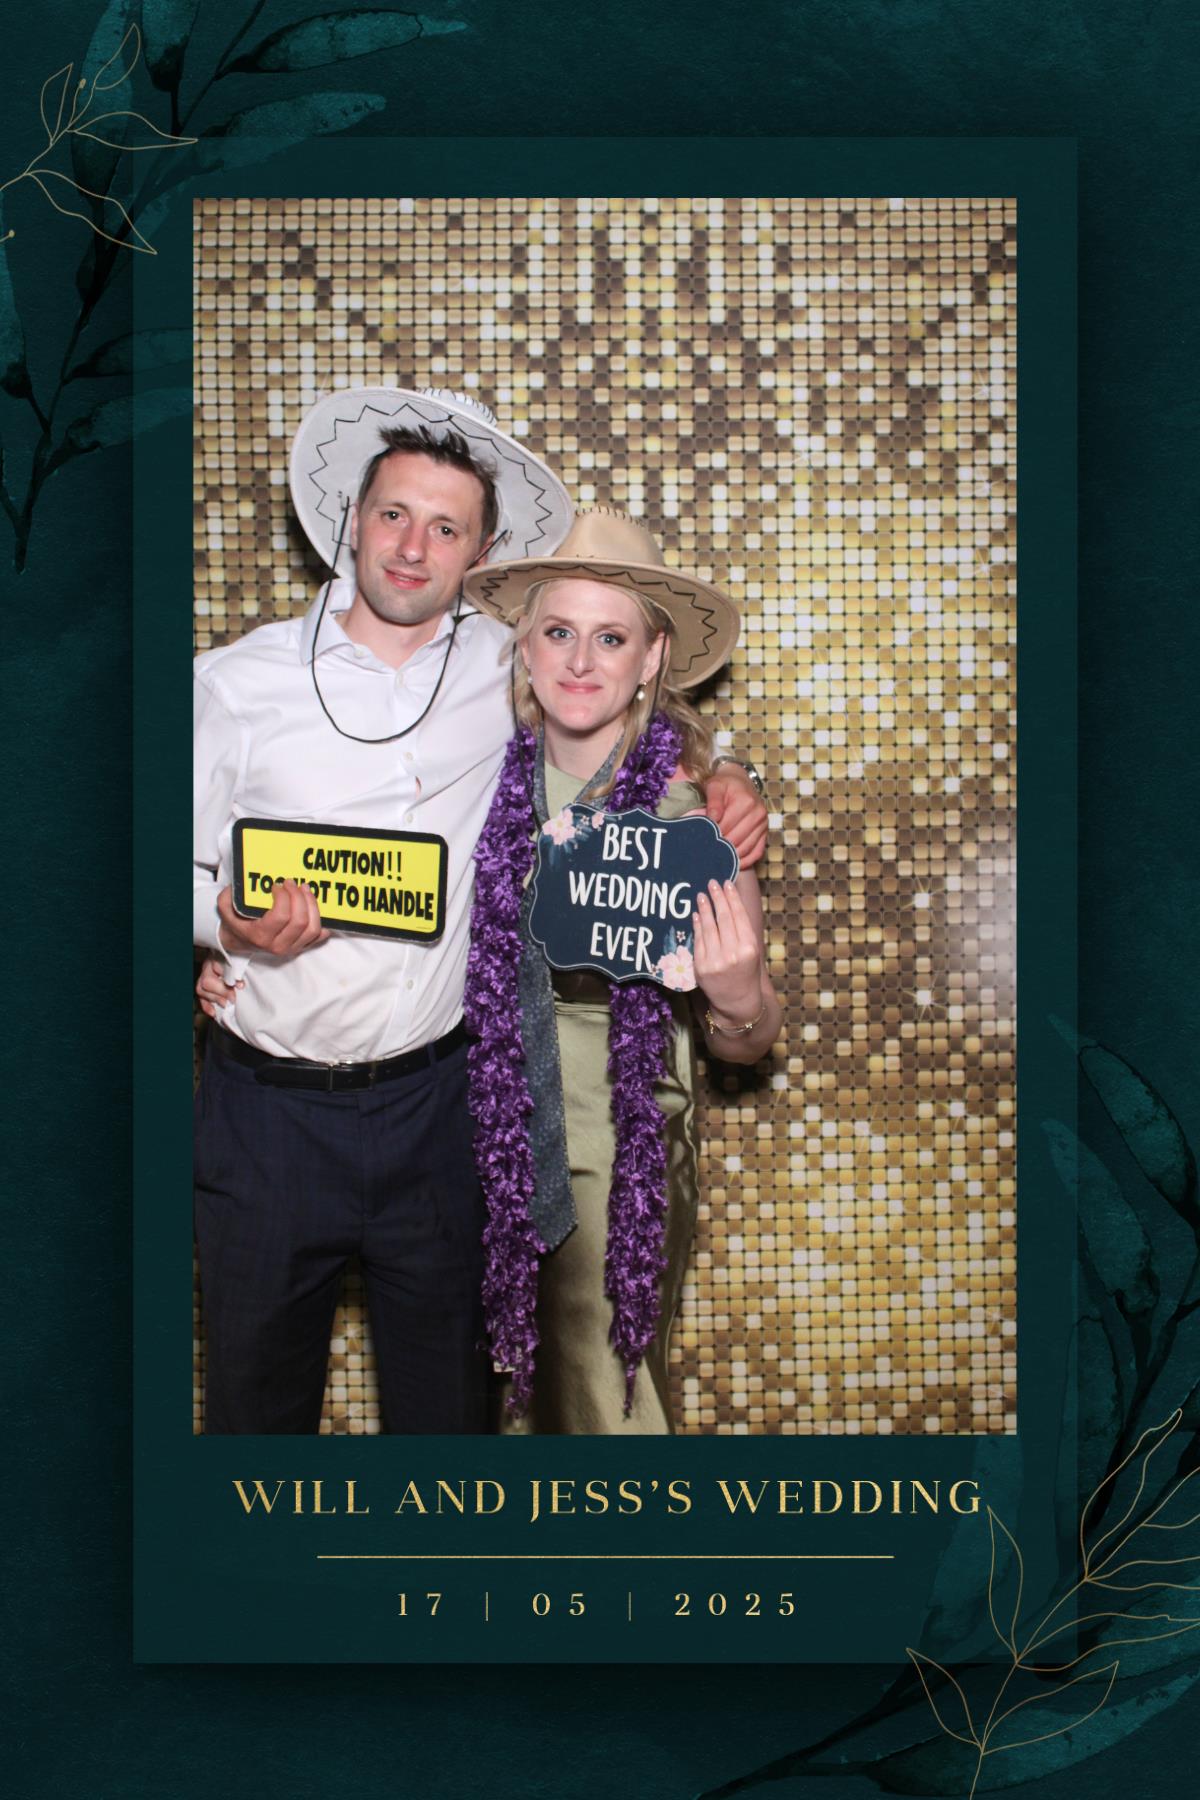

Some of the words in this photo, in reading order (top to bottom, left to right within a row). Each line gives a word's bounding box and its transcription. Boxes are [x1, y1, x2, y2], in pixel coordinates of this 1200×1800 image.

[303, 847, 402, 881] CAUTION!!
[602, 823, 668, 870] BEST
[335, 882, 359, 908] TO
[364, 886, 434, 921] HANDLE
[569, 870, 692, 919] WEDDING
[590, 922, 654, 972] EVER
